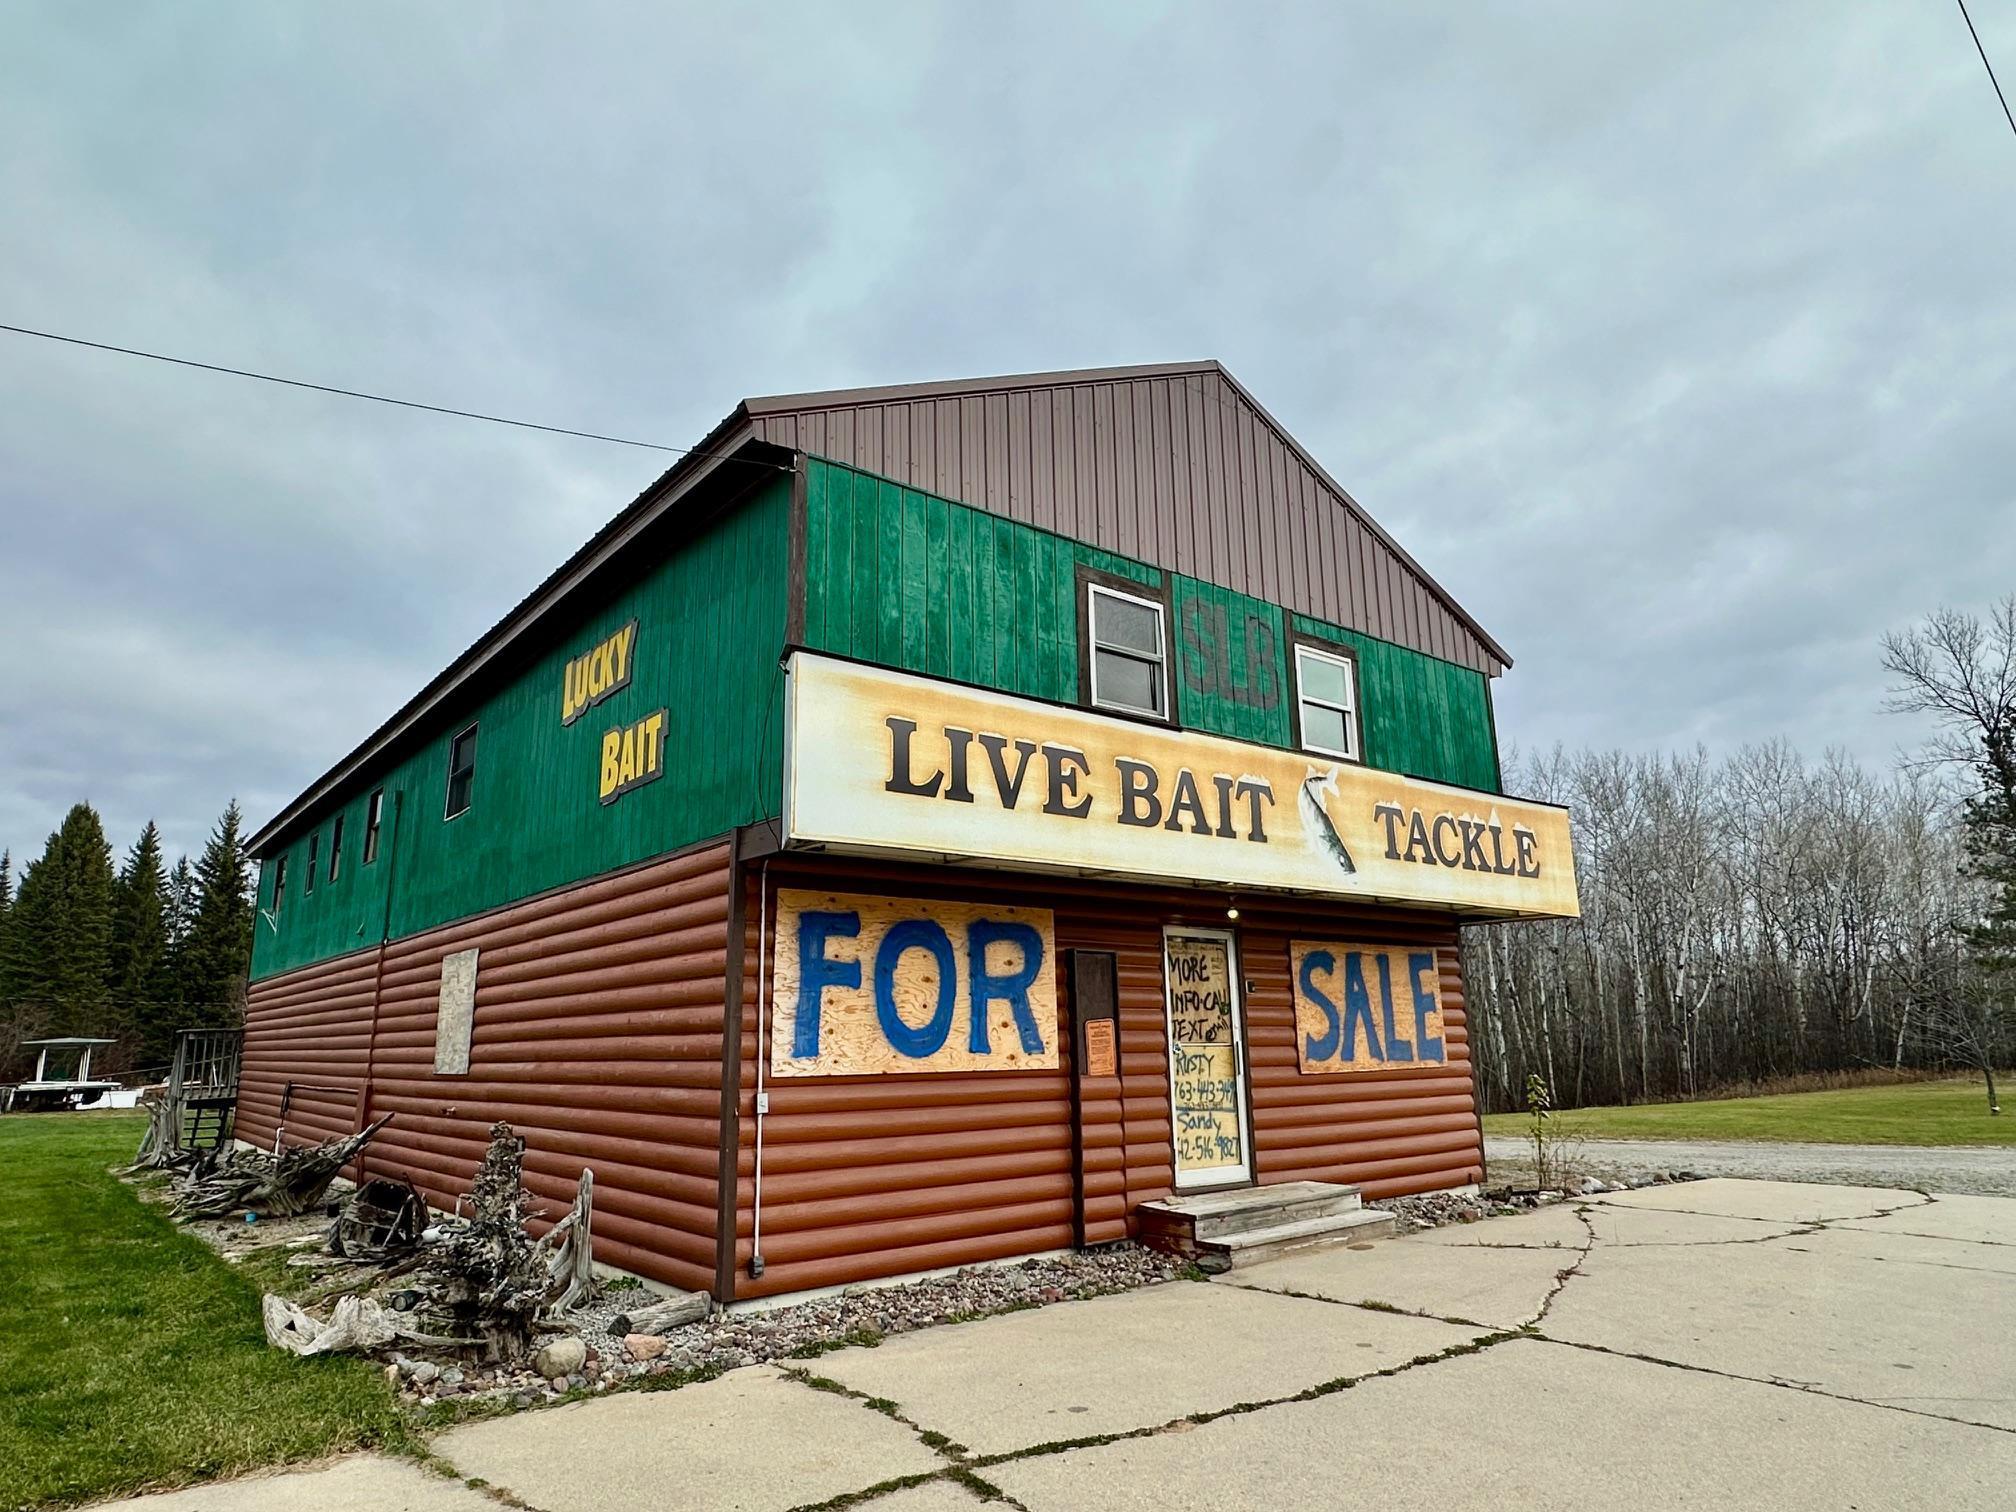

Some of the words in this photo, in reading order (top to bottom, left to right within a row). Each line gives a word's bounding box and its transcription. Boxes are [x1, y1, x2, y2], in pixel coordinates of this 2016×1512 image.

[563, 625, 632, 720] LUCKY
[600, 713, 662, 798] BAIT
[884, 714, 1093, 819] LIVE
[1115, 758, 1275, 844] BAIT
[1373, 804, 1541, 878] TACKLE
[791, 909, 1046, 1059] FOR
[1168, 954, 1210, 986] MORE
[1300, 949, 1445, 1062] SALE
[1172, 1019, 1208, 1041] TEXT
[1176, 1049, 1215, 1078] RUSTY
[1177, 1110, 1222, 1138] Sandy
